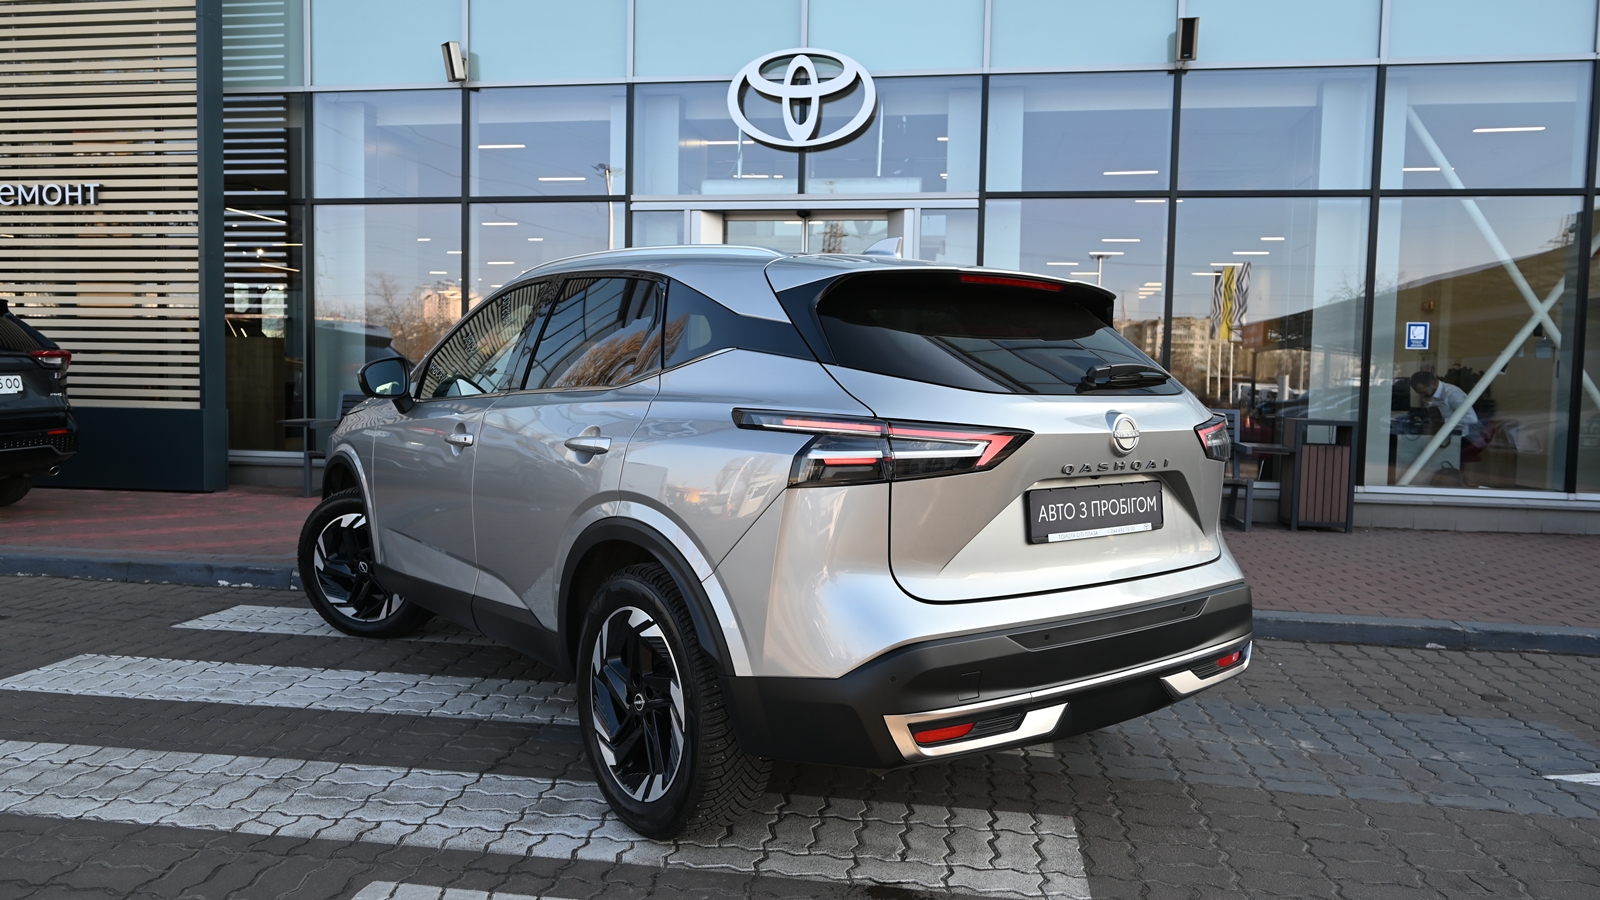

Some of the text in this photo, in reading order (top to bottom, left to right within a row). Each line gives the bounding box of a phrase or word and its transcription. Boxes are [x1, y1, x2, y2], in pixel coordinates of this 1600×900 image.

[1061, 459, 1169, 475] QASHQAI
[1038, 502, 1076, 522] АВТО
[1091, 495, 1157, 518] ПРОБІГОМ
